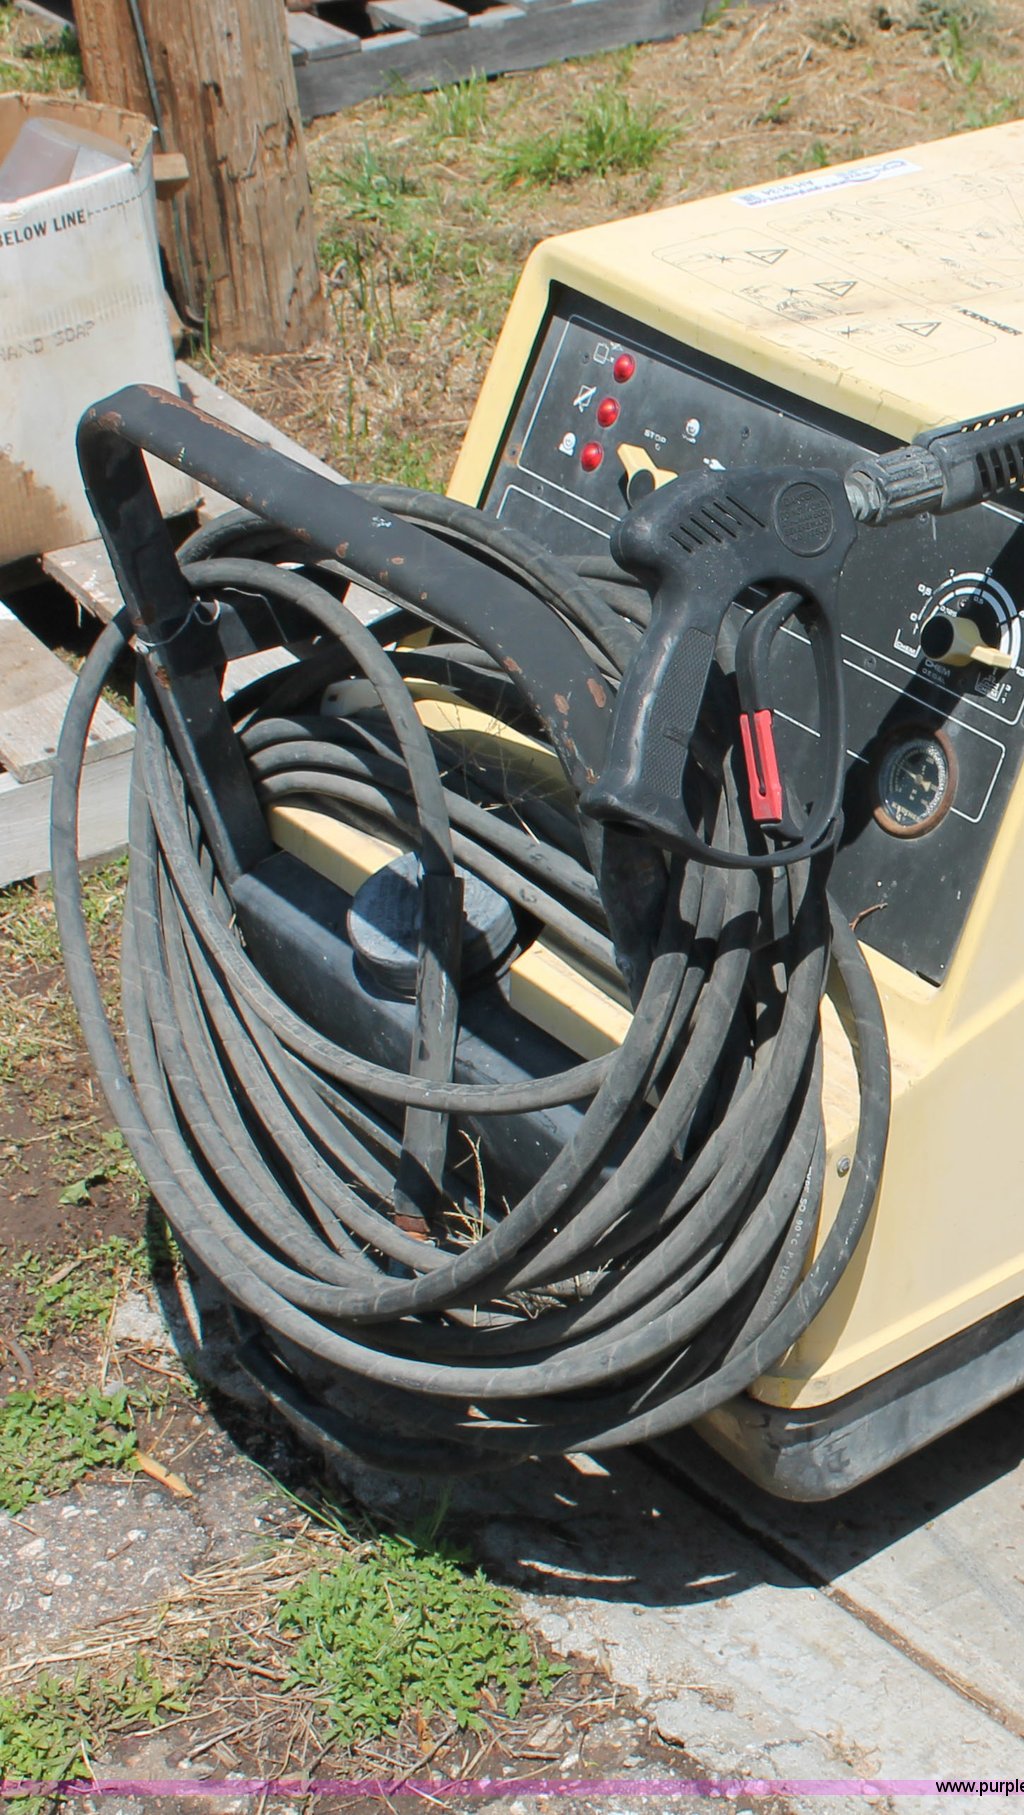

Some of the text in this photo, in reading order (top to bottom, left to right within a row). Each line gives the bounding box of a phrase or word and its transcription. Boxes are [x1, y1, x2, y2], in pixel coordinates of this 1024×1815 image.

[53, 209, 87, 232] LINE
[53, 320, 95, 346] SOAP
[643, 428, 668, 444] STOP
[924, 659, 951, 677] CHEM
[798, 1197, 808, 1212] SO
